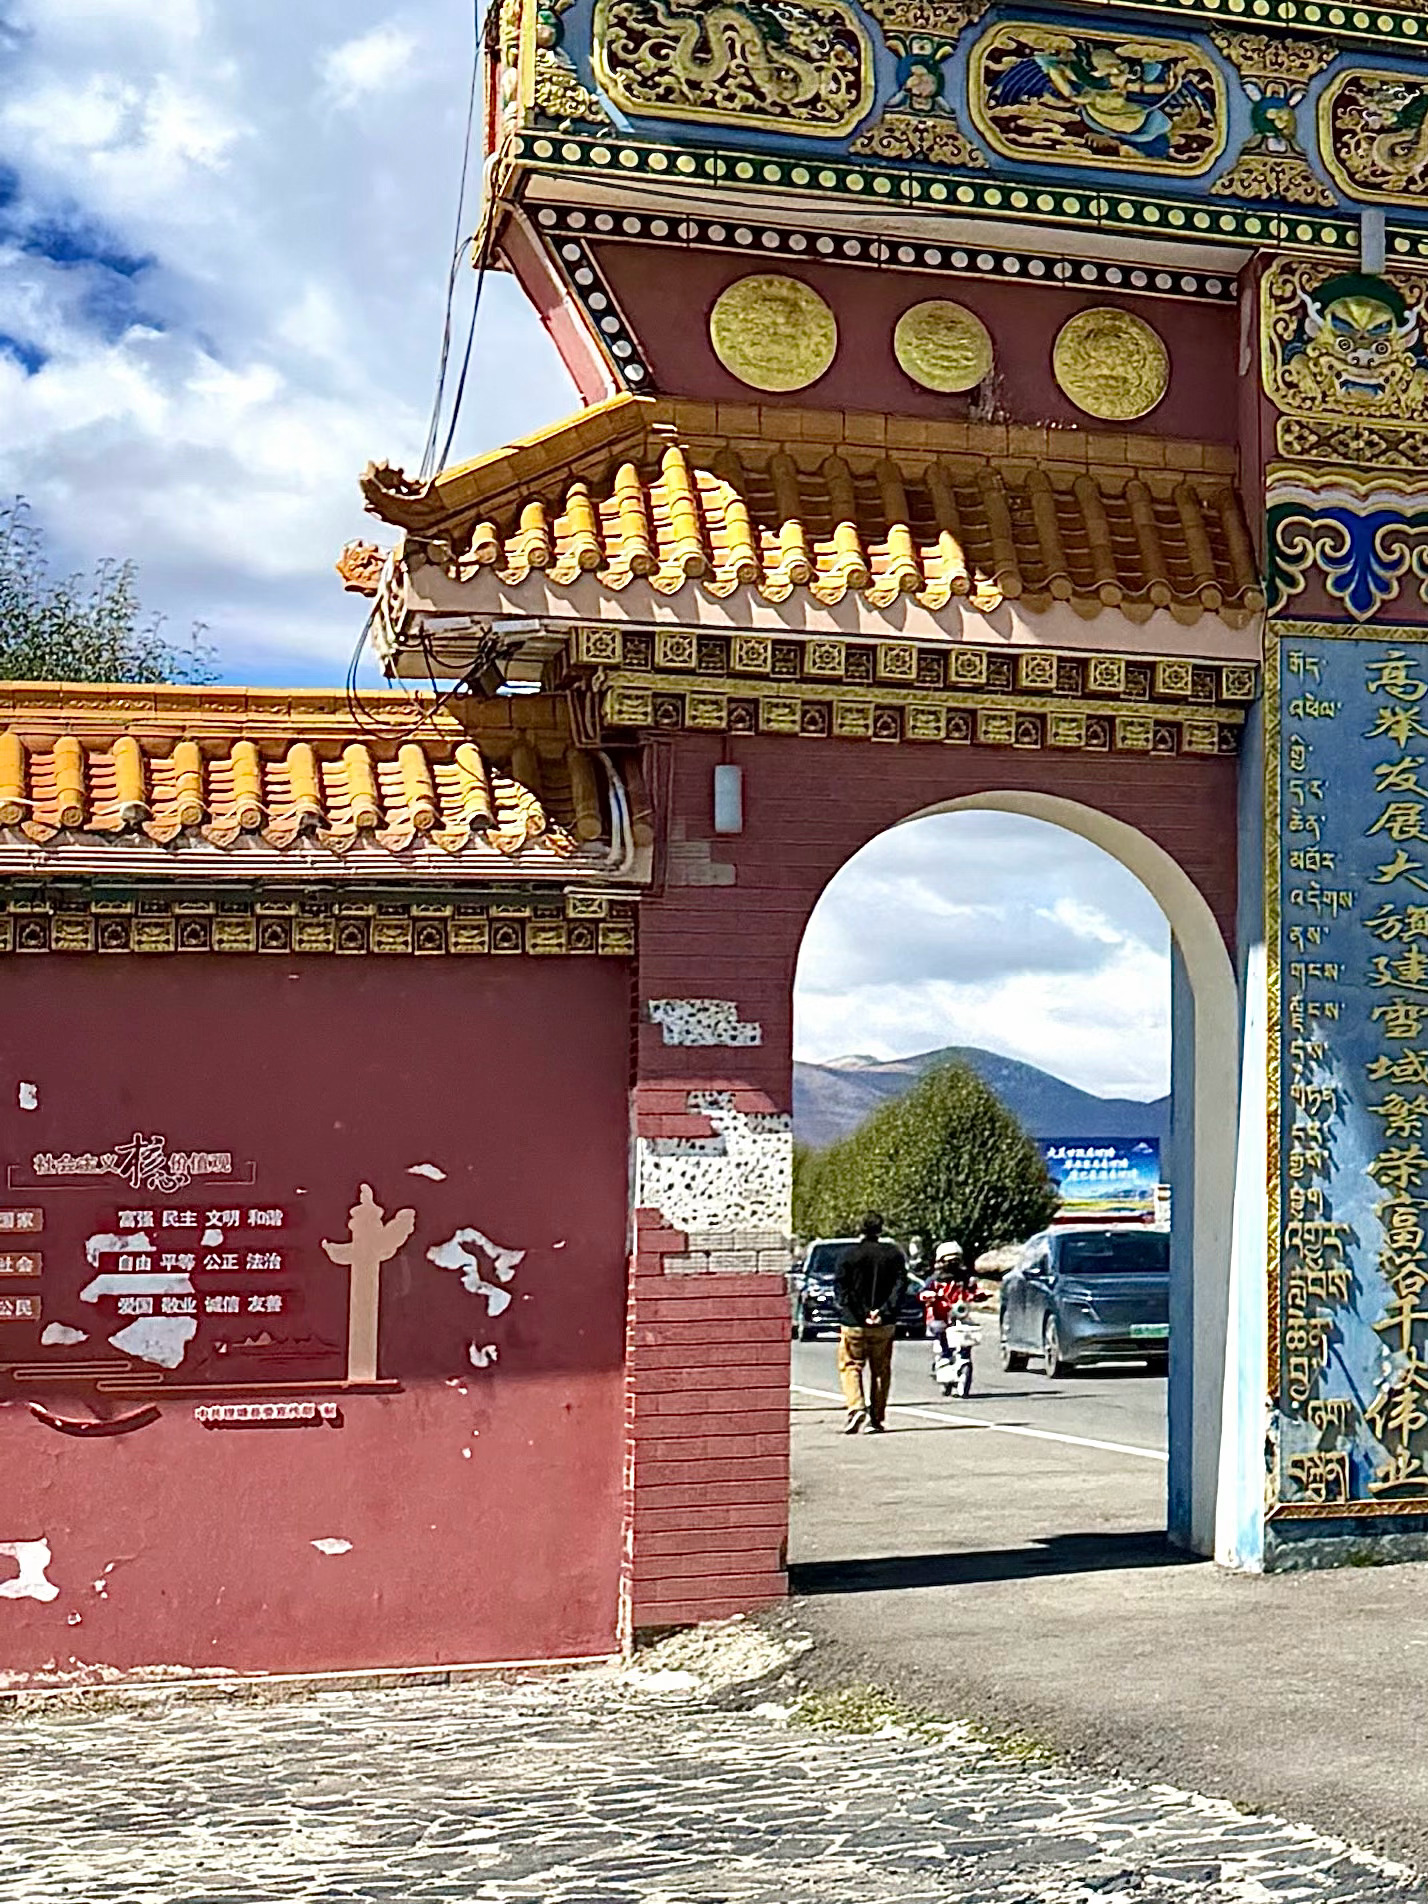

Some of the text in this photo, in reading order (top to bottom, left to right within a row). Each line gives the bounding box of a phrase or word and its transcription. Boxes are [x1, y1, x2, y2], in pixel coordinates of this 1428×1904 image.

[32, 1133, 233, 1193] 社会主义核心价值观
[117, 1209, 283, 1229] 富强 民主 文明 和谐
[118, 1252, 282, 1272] 自由 平等 公正 法治
[0, 1298, 34, 1316] 公民
[117, 1296, 283, 1315] 爱国 敬业 诚信 友善
